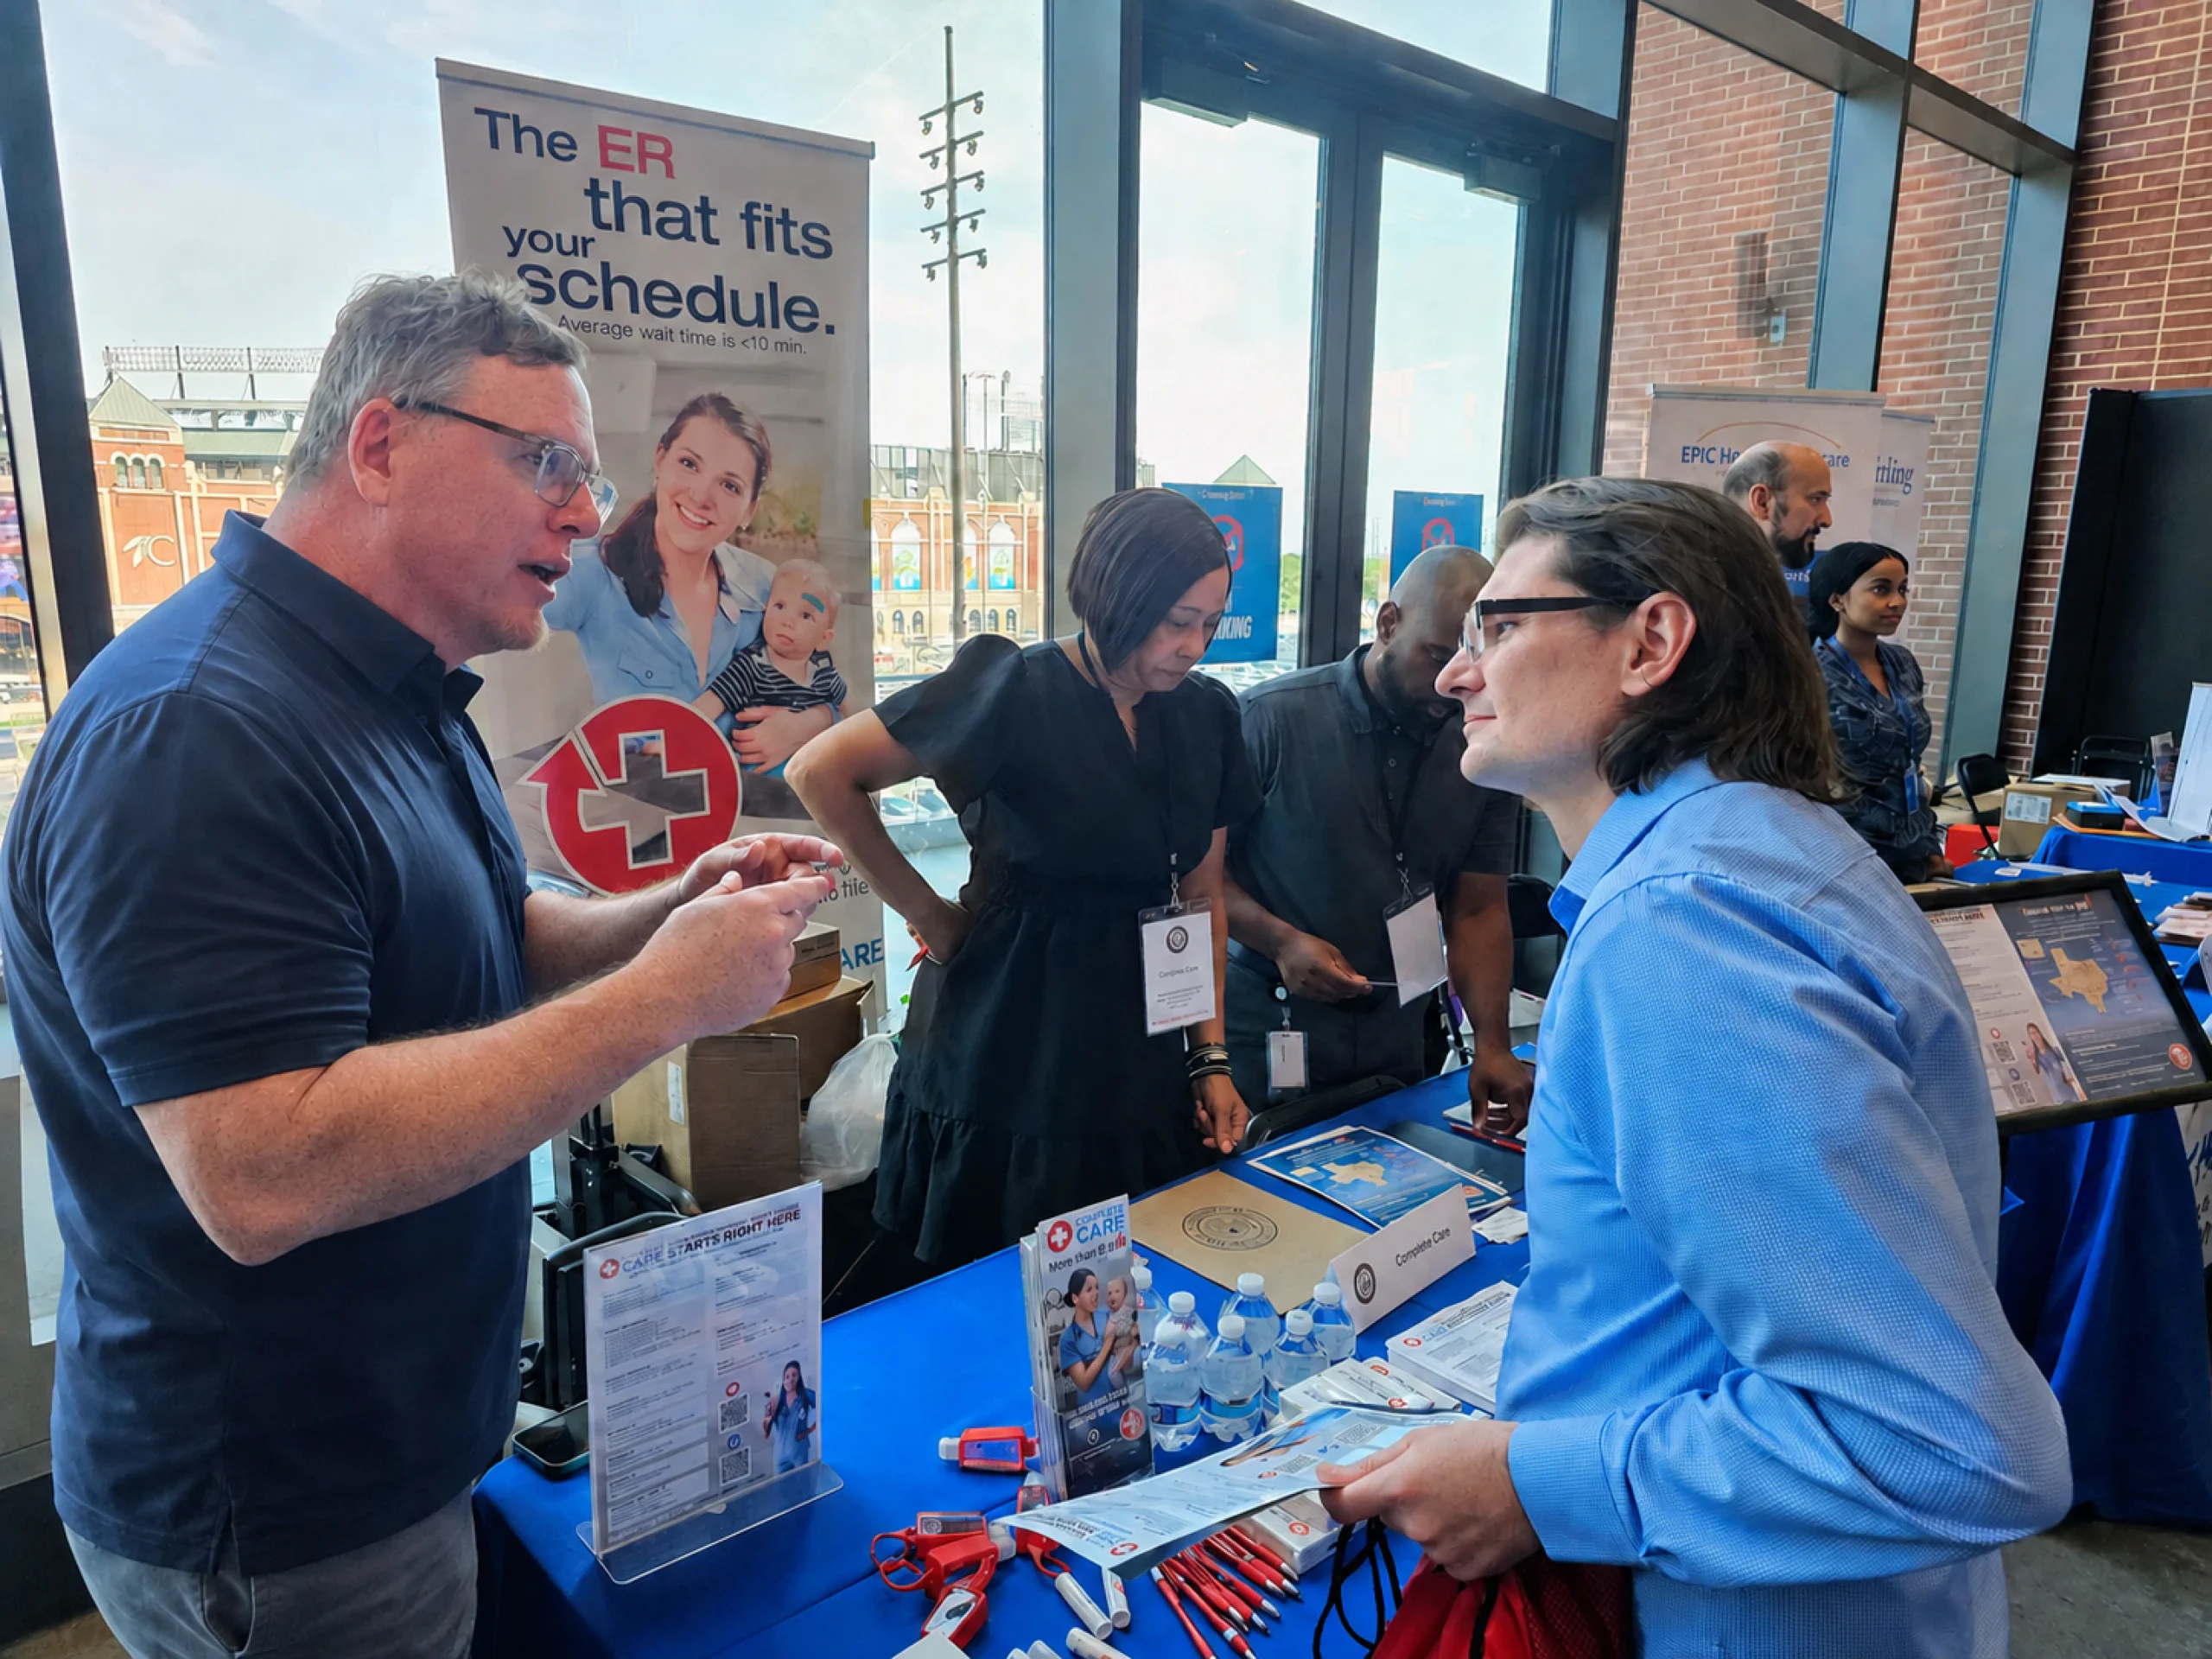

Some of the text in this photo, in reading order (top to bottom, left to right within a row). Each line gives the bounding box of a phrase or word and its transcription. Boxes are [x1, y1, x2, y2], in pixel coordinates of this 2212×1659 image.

[474, 107, 675, 179] The ER
[584, 177, 833, 259] that fits
[502, 225, 596, 258] your
[517, 261, 835, 335] schedule.
[558, 314, 807, 354] Average wait time is <10 min.
[1681, 446, 1715, 464] EPIC
[1213, 615, 1253, 639] OKING
[842, 938, 884, 969] ARE
[622, 1250, 664, 1273] CARE
[668, 1234, 721, 1259] STARTS
[723, 1219, 762, 1242] RIGHT
[766, 1209, 801, 1228] HERE
[1076, 1214, 1124, 1243] CARE
[1049, 1257, 1073, 1273] More
[1075, 1249, 1096, 1263] than
[1395, 1227, 1451, 1267] Complete Care
